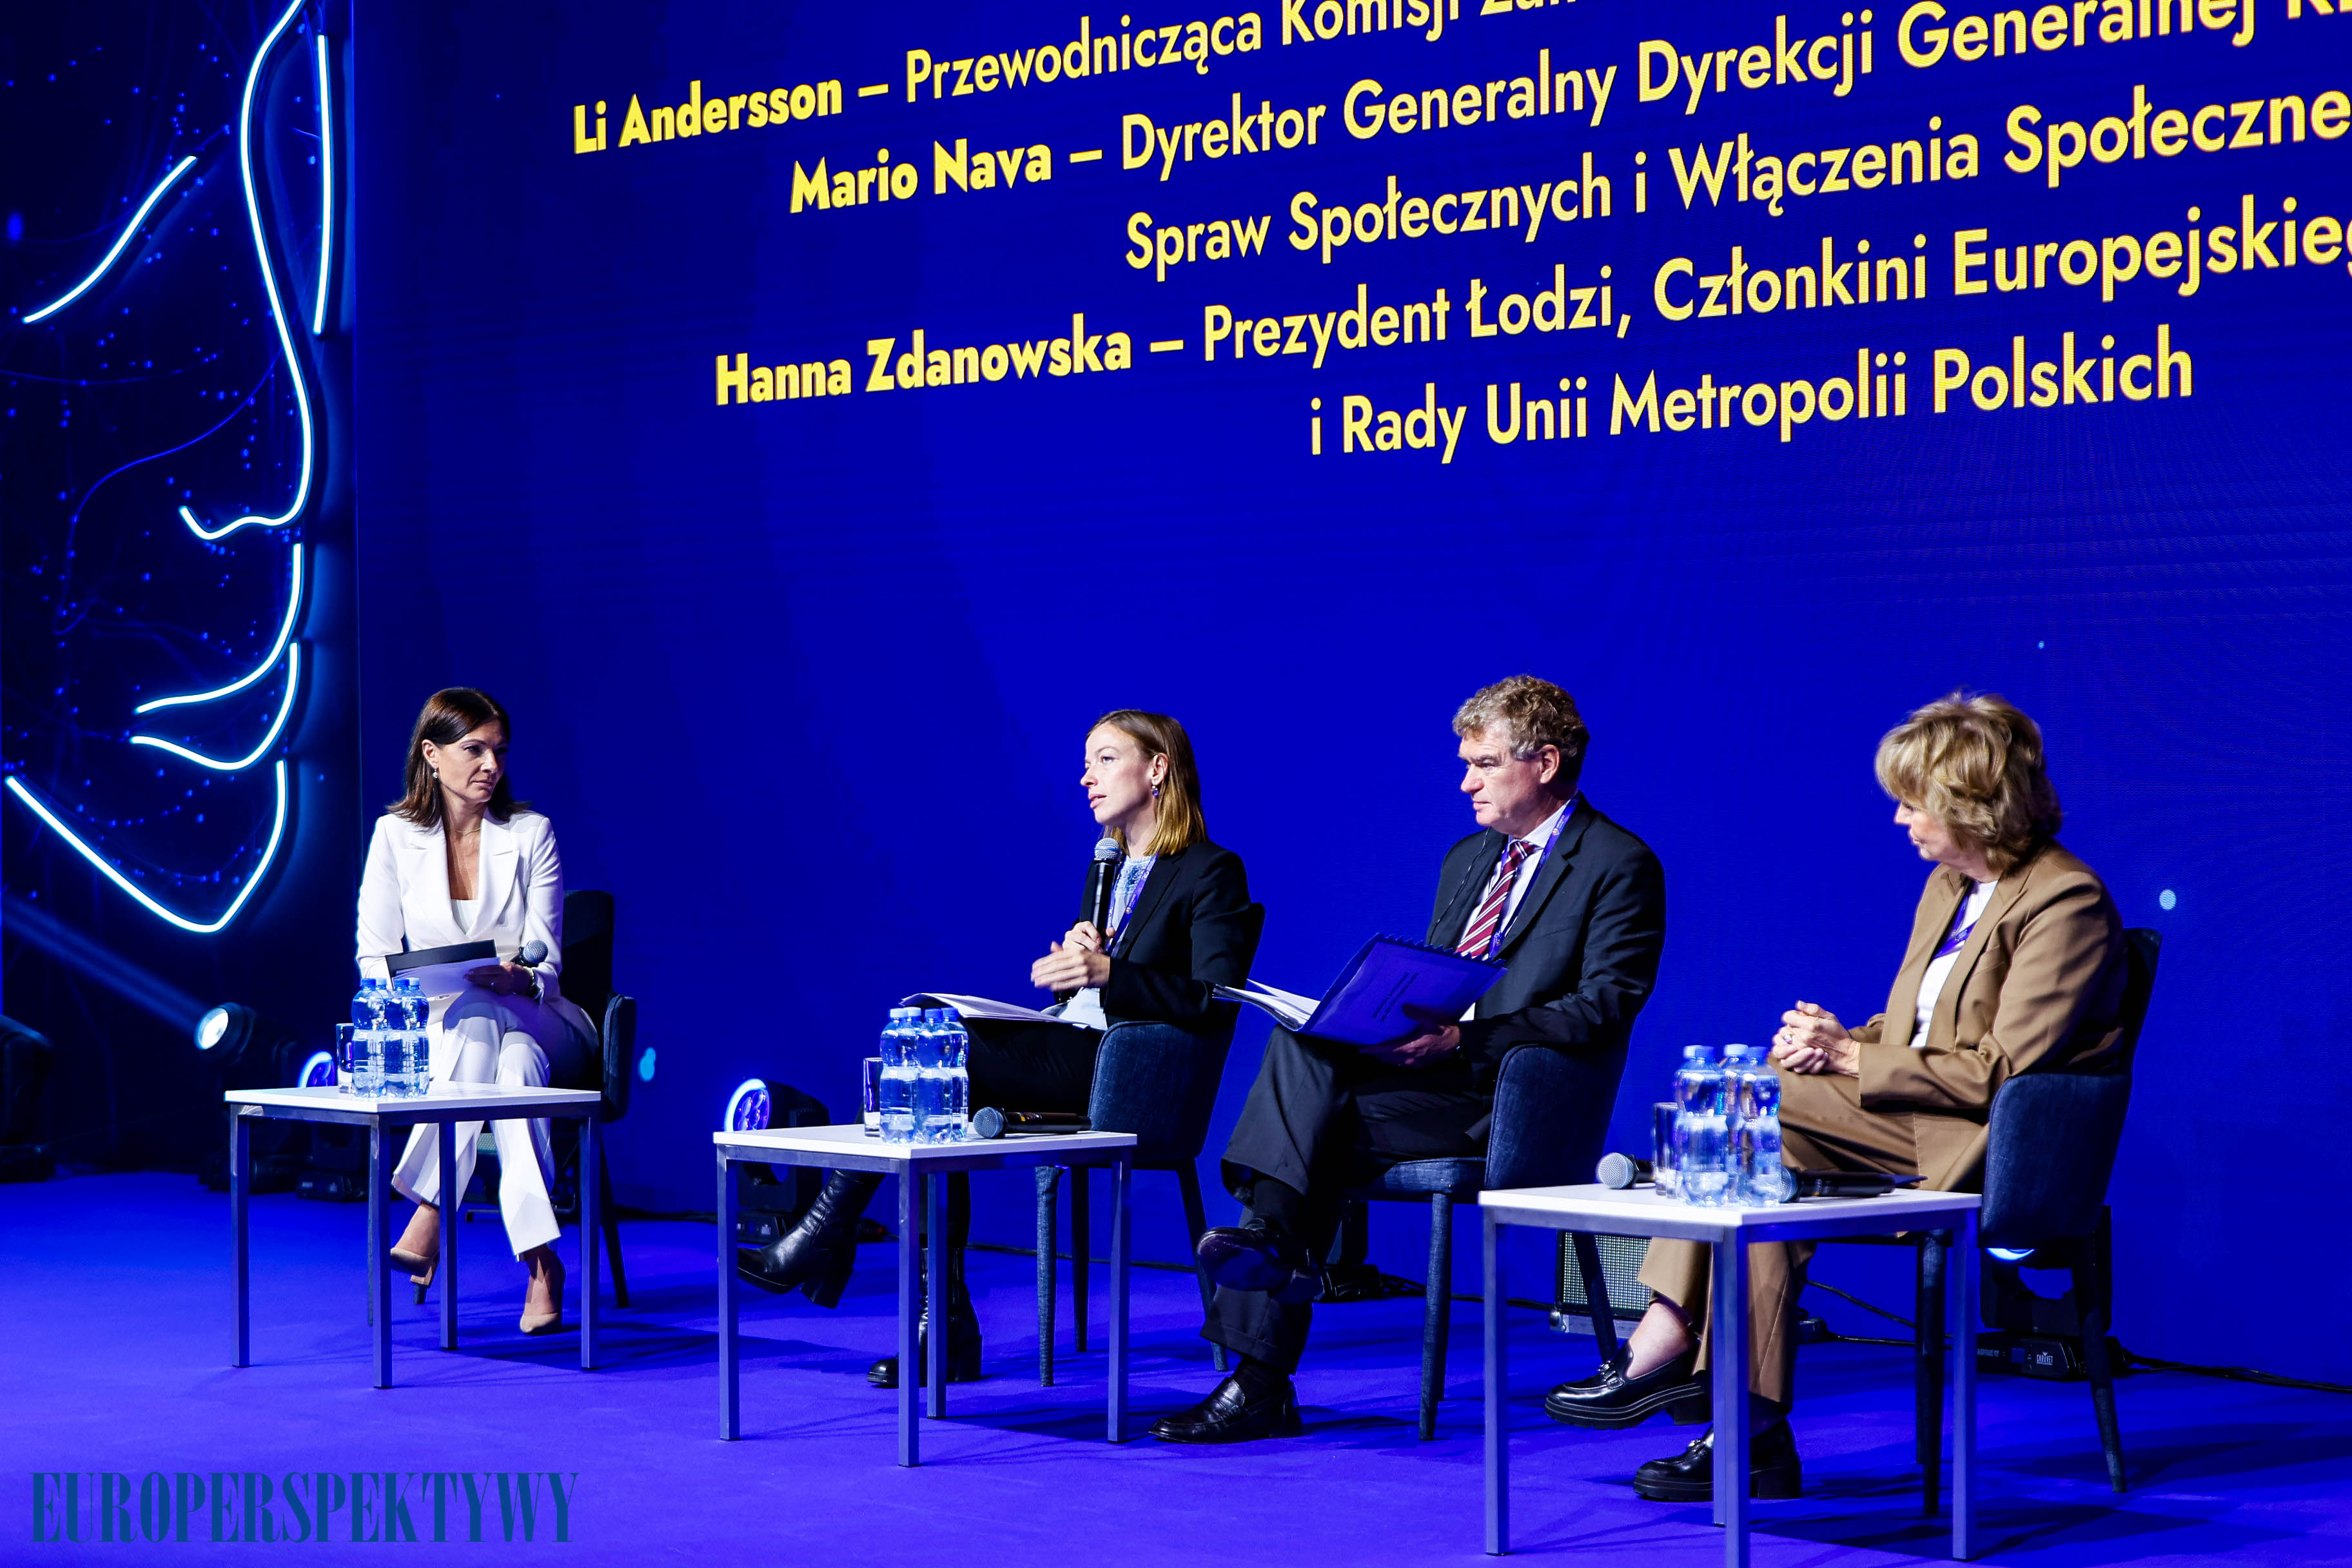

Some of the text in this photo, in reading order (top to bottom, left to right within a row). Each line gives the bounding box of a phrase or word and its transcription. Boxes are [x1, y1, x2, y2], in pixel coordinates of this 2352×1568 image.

[573, 99, 607, 155] Li
[618, 79, 843, 148] Andersson
[906, 12, 1262, 104] Przewodnicząca
[789, 147, 919, 214] Mario
[934, 137, 1052, 195] Nava
[1122, 92, 1328, 182] Dyrektor
[1343, 48, 1618, 140] Generalny
[1638, 8, 1874, 116] Dyrekcji
[1897, 0, 2255, 68] Generalnej
[1124, 211, 1272, 283] Spraw
[1288, 151, 1611, 265] Społecznych
[1634, 150, 1647, 213] i
[1667, 115, 1979, 217] Włączenia
[715, 352, 852, 406] Hanna
[865, 312, 1132, 393] Zdanowska
[1204, 282, 1451, 369] Prezydent
[1464, 263, 1632, 339] Łodzi,
[1653, 233, 1927, 322] Członkini
[1954, 193, 2352, 303] Europejskie
[1310, 323, 2193, 465] i Rady Unii Metropolii Polskich
